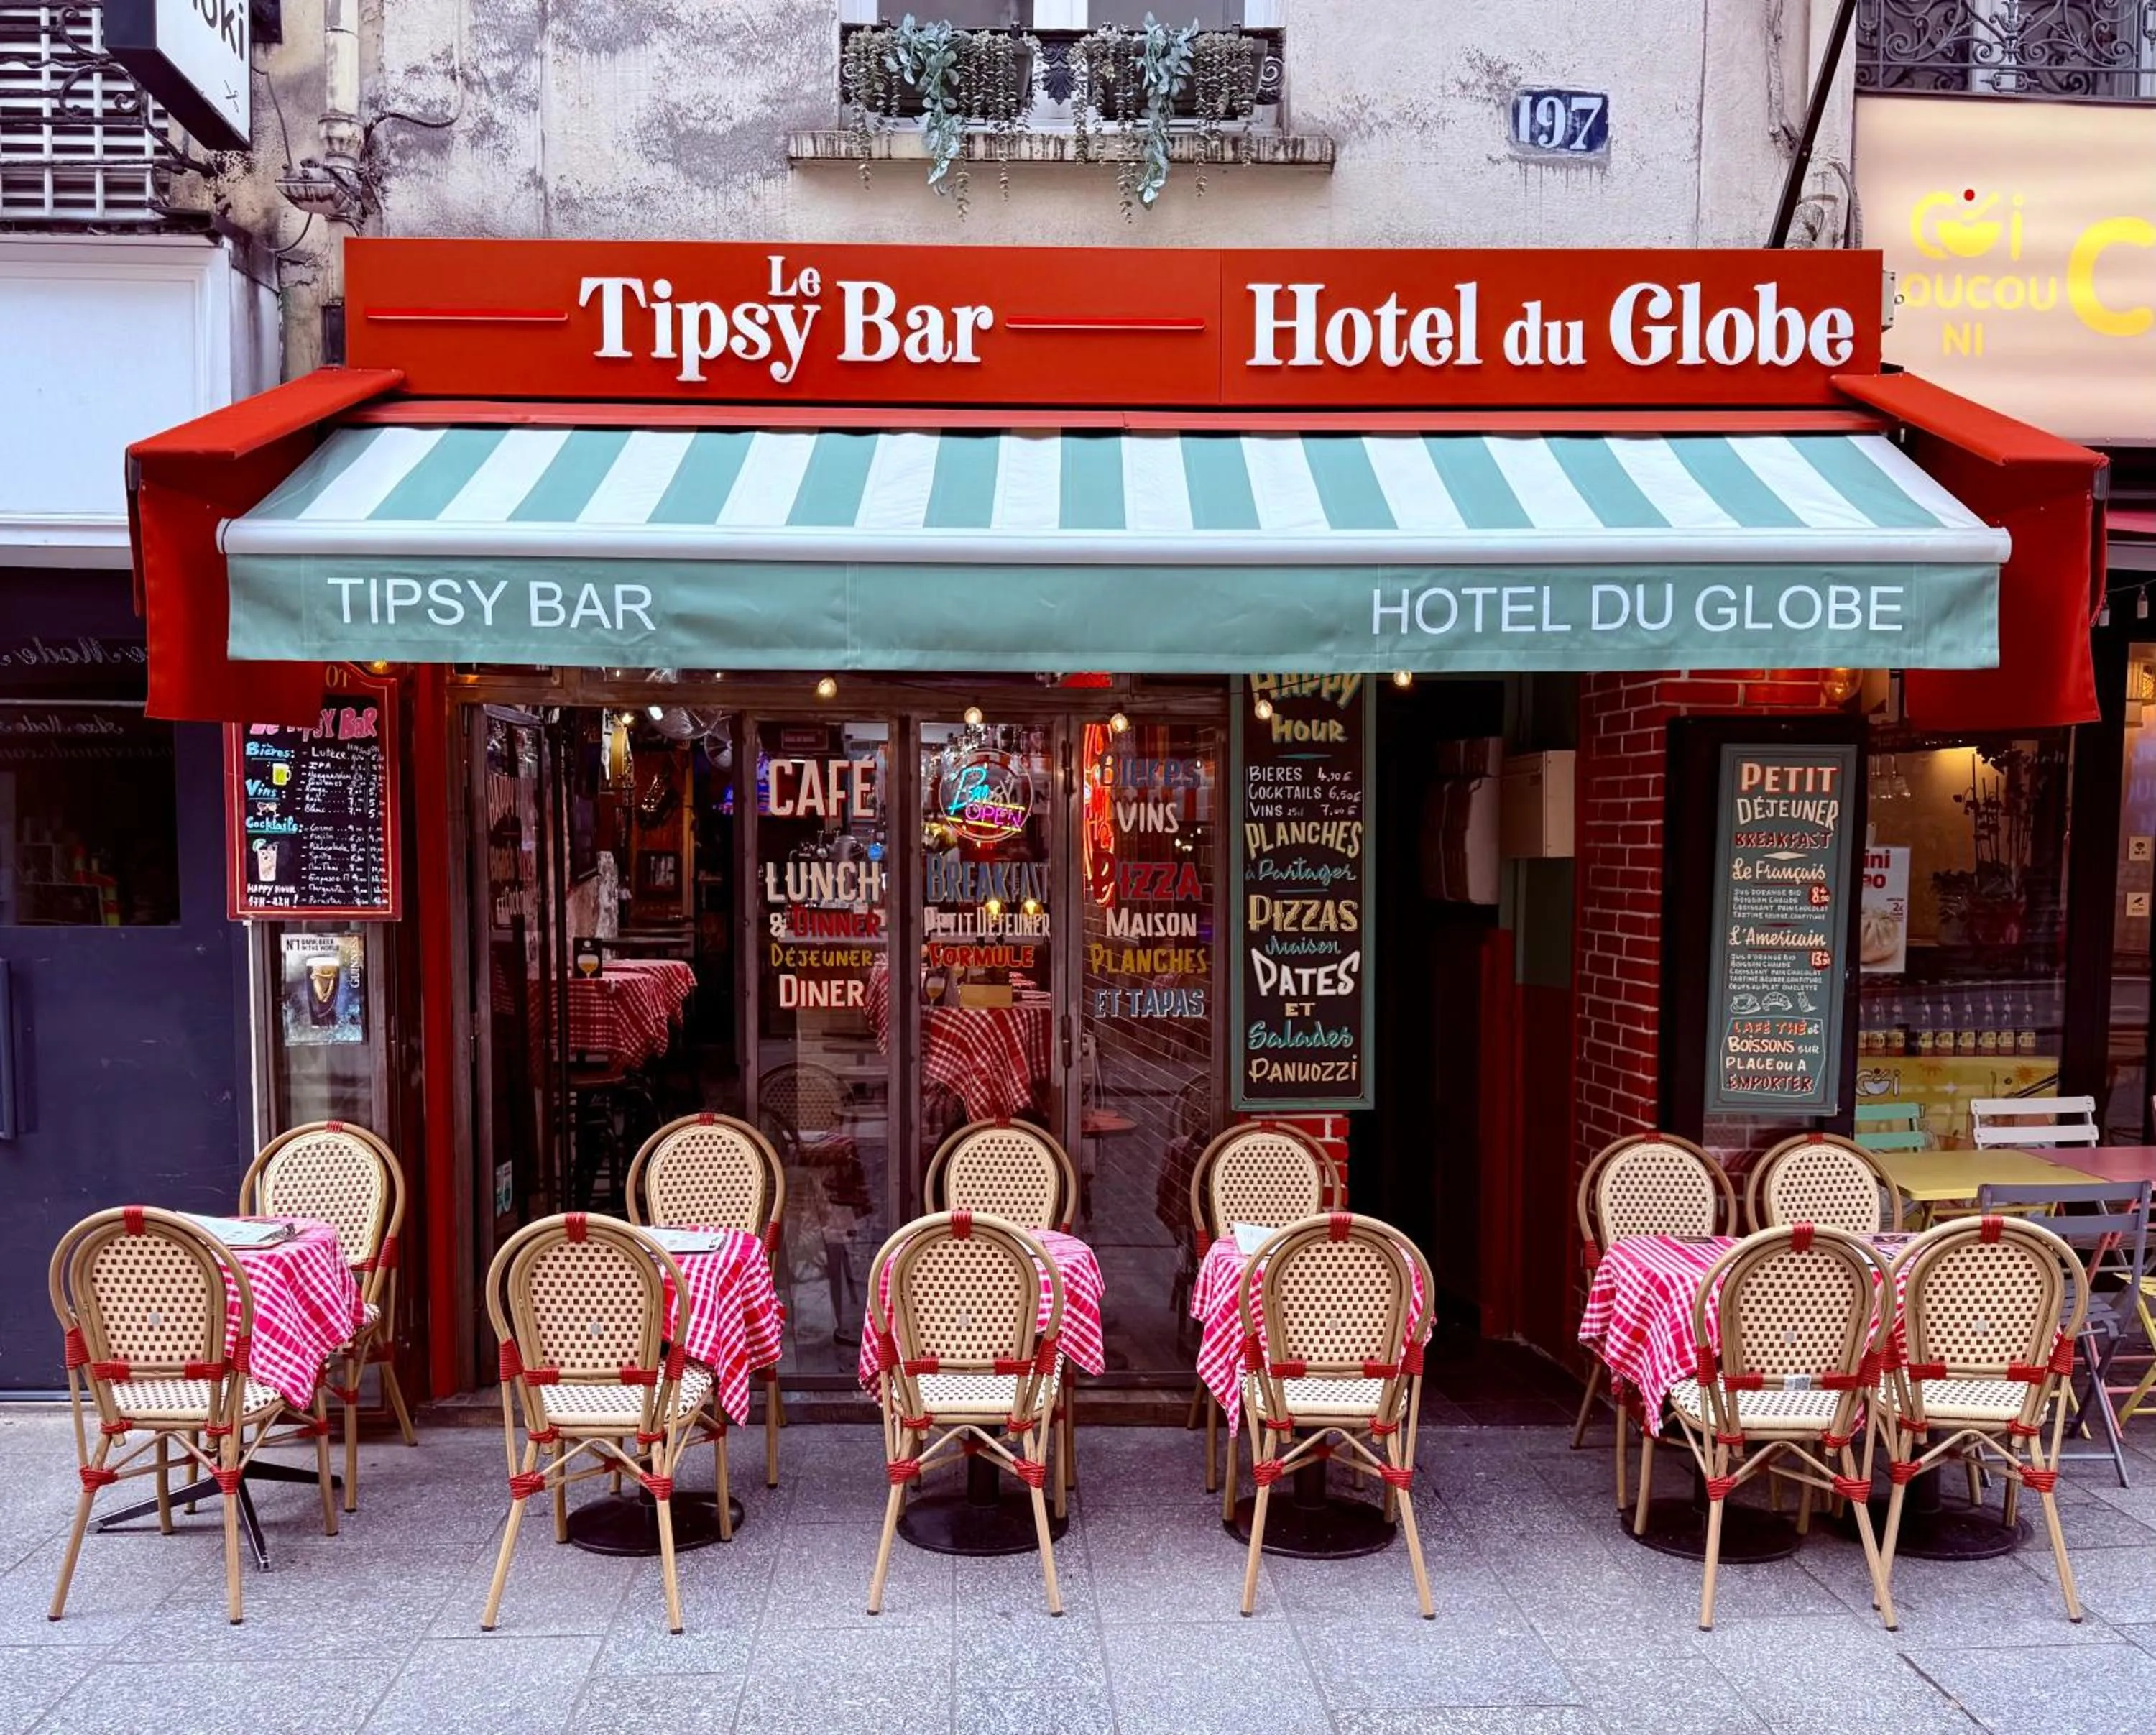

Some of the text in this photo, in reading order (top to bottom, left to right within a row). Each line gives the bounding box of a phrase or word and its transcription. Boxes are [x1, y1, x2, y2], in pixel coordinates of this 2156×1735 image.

[1519, 94, 1606, 151] 197
[767, 255, 821, 297] Le
[1902, 272, 2057, 310] OUCOU
[579, 277, 993, 383] Tipsy Bar
[1245, 281, 1855, 367] Hotel du Globe
[1943, 321, 1984, 357] NI
[328, 577, 655, 630] TIPSY BAR
[1372, 583, 1904, 635] HOTEL DU GLOBE
[1271, 712, 1348, 744] HOUR
[1248, 782, 1322, 800] COCKTAILS
[1741, 762, 1838, 793] PETIT
[965, 802, 1023, 829] OPEN
[1116, 801, 1179, 834] VINS
[1249, 801, 1284, 817] VINS
[1736, 796, 1840, 831] DÉJEUNER
[1244, 822, 1363, 861] PLANCHES
[1734, 831, 1833, 850] BREAKFAST
[765, 861, 883, 903] LUNCH
[926, 855, 1050, 903] BREAKFAST
[1092, 852, 1202, 903] PIZZA
[1755, 860, 1826, 884] Français
[769, 906, 882, 938] & DINNER
[924, 906, 972, 937] PETIT
[1105, 908, 1197, 937] MAISON
[1247, 894, 1359, 932] PIZZAS
[928, 942, 1036, 968] FORMULE
[1089, 947, 1208, 974] PLANCHES
[1250, 947, 1361, 997] PATES
[778, 974, 865, 1009] DINER
[1094, 988, 1204, 1018] ET TAPAS
[1284, 1003, 1316, 1018] ET
[1248, 1019, 1354, 1050] Salades
[1726, 1057, 1774, 1071] PLACE
